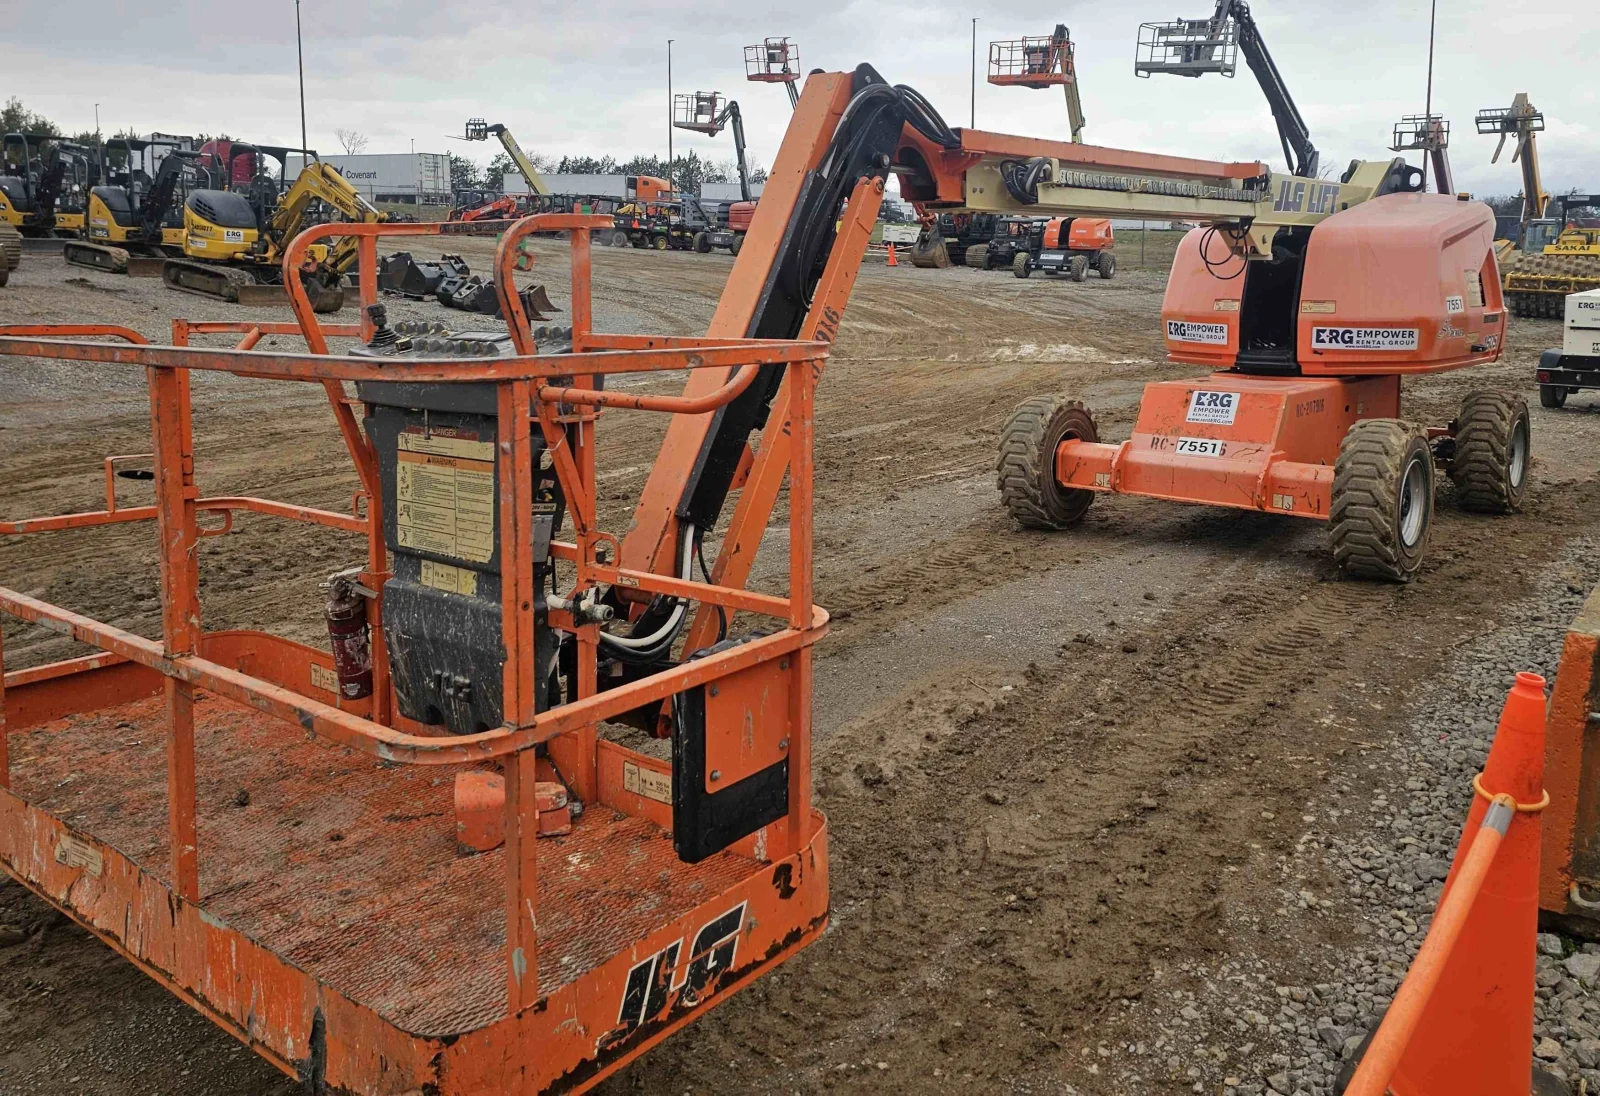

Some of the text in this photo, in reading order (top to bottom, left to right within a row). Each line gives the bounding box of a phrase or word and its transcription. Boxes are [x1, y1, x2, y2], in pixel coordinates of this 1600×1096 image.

[346, 170, 377, 179] Covenant
[1273, 180, 1340, 214] JLG LIFT
[1446, 298, 1463, 311] 7551
[1168, 321, 1225, 337] ERG EMPOWER
[1315, 328, 1415, 345] ERG EMPOWER
[1195, 392, 1233, 408] ERG
[1193, 406, 1230, 415] EMPOWER
[1179, 440, 1217, 454] 7551
[431, 456, 457, 467] WARNING
[594, 899, 748, 1057] JLG
